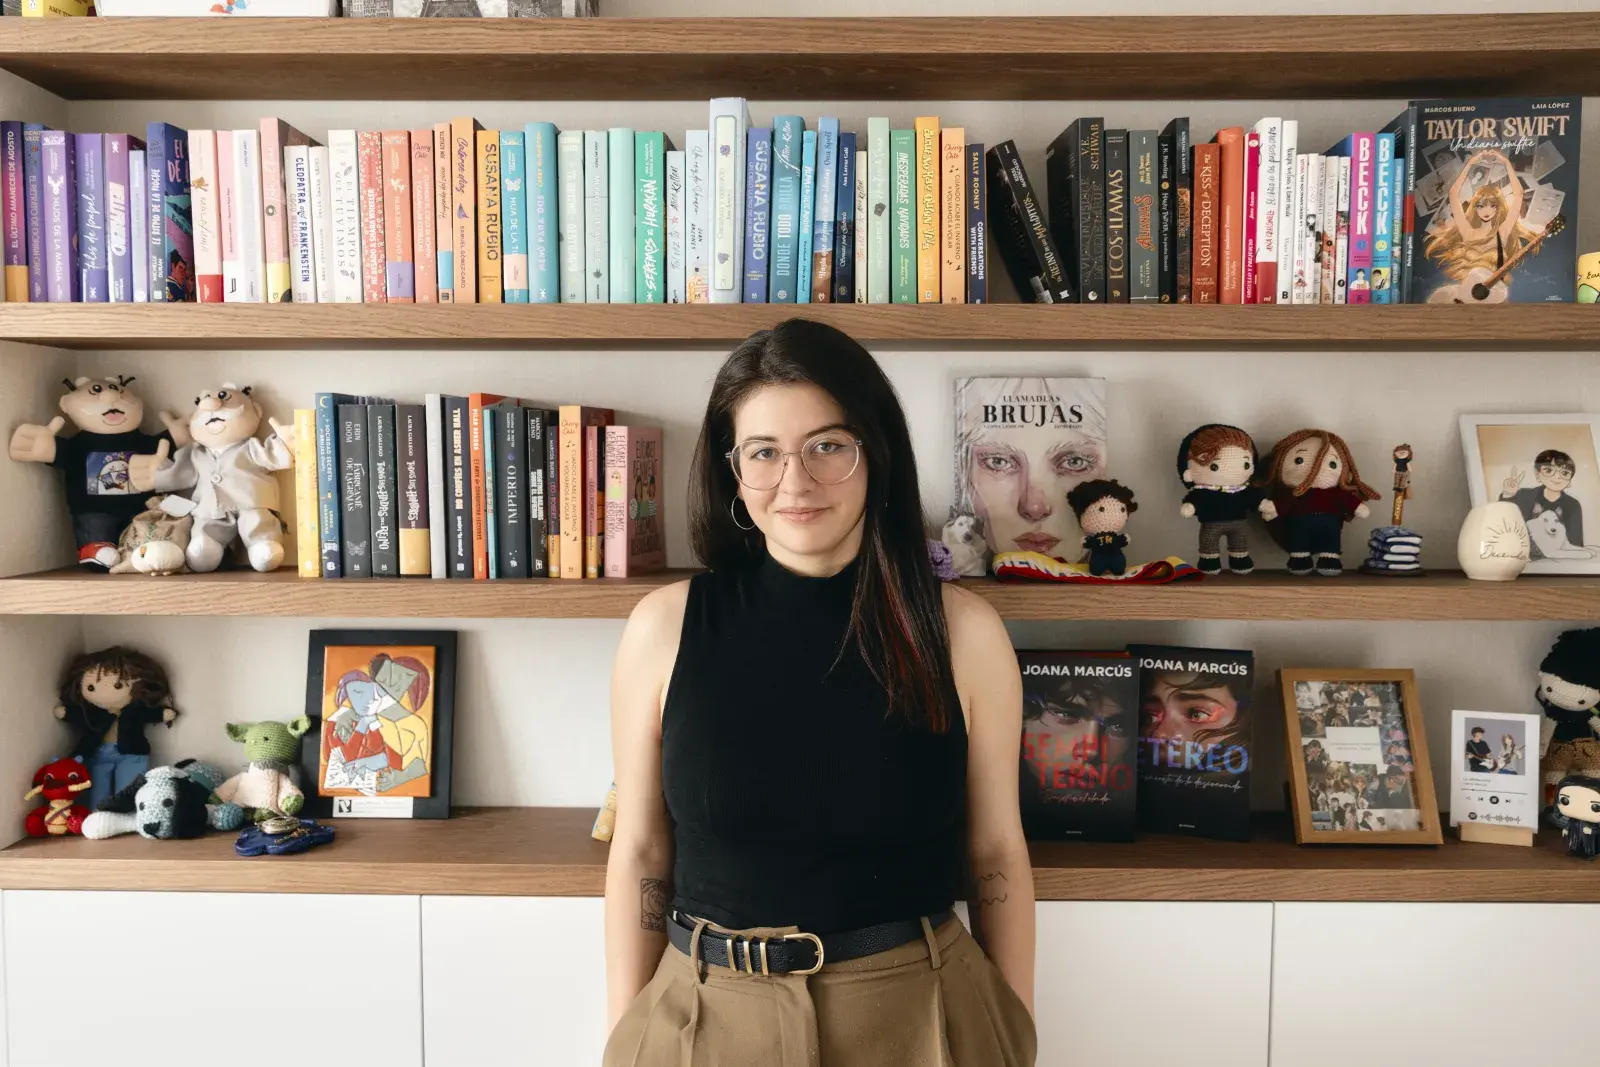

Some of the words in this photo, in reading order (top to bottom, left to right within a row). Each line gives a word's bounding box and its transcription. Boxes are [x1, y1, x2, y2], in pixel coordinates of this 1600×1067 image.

[1424, 117, 1496, 140] TAYLOR
[1503, 115, 1570, 138] SWIFT
[7, 132, 16, 160] AGOSTO
[174, 139, 184, 158] EL
[1081, 137, 1090, 156] V.E.
[1090, 124, 1099, 170] SCHWAB
[1450, 138, 1465, 151] Un
[1466, 137, 1499, 149] diario
[1501, 136, 1535, 155] swiftie
[9, 162, 16, 170] DE
[168, 159, 181, 182] DE
[486, 143, 497, 208] SUSANA
[754, 140, 768, 207] SUSANA
[899, 152, 909, 203] INESPERADAS
[1200, 166, 1212, 189] KISS
[296, 158, 306, 203] CLEOPATRA
[1356, 137, 1370, 235] BECK
[1376, 138, 1390, 235] BECK
[151, 193, 160, 201] LA
[151, 203, 160, 212] DE
[640, 179, 659, 228] HURACÁN
[1108, 170, 1124, 229] LLAMAS
[10, 212, 18, 239] ÚLTIMO
[346, 198, 356, 257] TIEMPO
[511, 219, 517, 230] DE
[778, 214, 791, 239] TODO
[897, 207, 909, 248] NAVIDADES
[1023, 192, 1047, 239] MALDITOS
[1134, 194, 1156, 251] ALIANZAS
[11, 240, 18, 248] EL
[53, 225, 60, 236] DE
[54, 239, 61, 250] LA
[336, 196, 345, 266] TUVIMOS
[487, 213, 498, 260] RUBIO
[511, 232, 518, 243] LA
[753, 211, 765, 260] RUBIO
[1201, 201, 1211, 266] DECEPTION
[300, 222, 310, 282] FRANKENSTEIN
[643, 238, 659, 291] SEREMOS
[776, 244, 790, 276] DONDE
[1044, 252, 1060, 279] REINO
[1109, 237, 1124, 279] ECOS
[453, 408, 461, 428] HALL
[983, 404, 1083, 427] BRUJAS
[453, 430, 462, 454] ASHER
[606, 432, 616, 468] BENAVENT
[616, 436, 626, 468] ELÍSABET
[406, 460, 415, 478] TODOS
[454, 456, 462, 466] EN
[354, 463, 365, 509] FABRICANTE
[453, 468, 463, 497] CONFÍES
[507, 465, 518, 525] IMPERIO
[376, 489, 390, 516] HADAS
[406, 490, 420, 520] HOMBRES
[455, 499, 463, 509] NO
[606, 502, 616, 540] RECUERDOS
[616, 502, 625, 532] SEREMOS
[375, 526, 390, 550] REINO
[1480, 545, 1527, 560] December
[1023, 665, 1070, 676] JOANA
[1074, 664, 1132, 678] MARCÚS
[1139, 658, 1183, 672] JOANA
[1188, 661, 1247, 676] MARCÚS
[1034, 762, 1133, 790] TERNO
